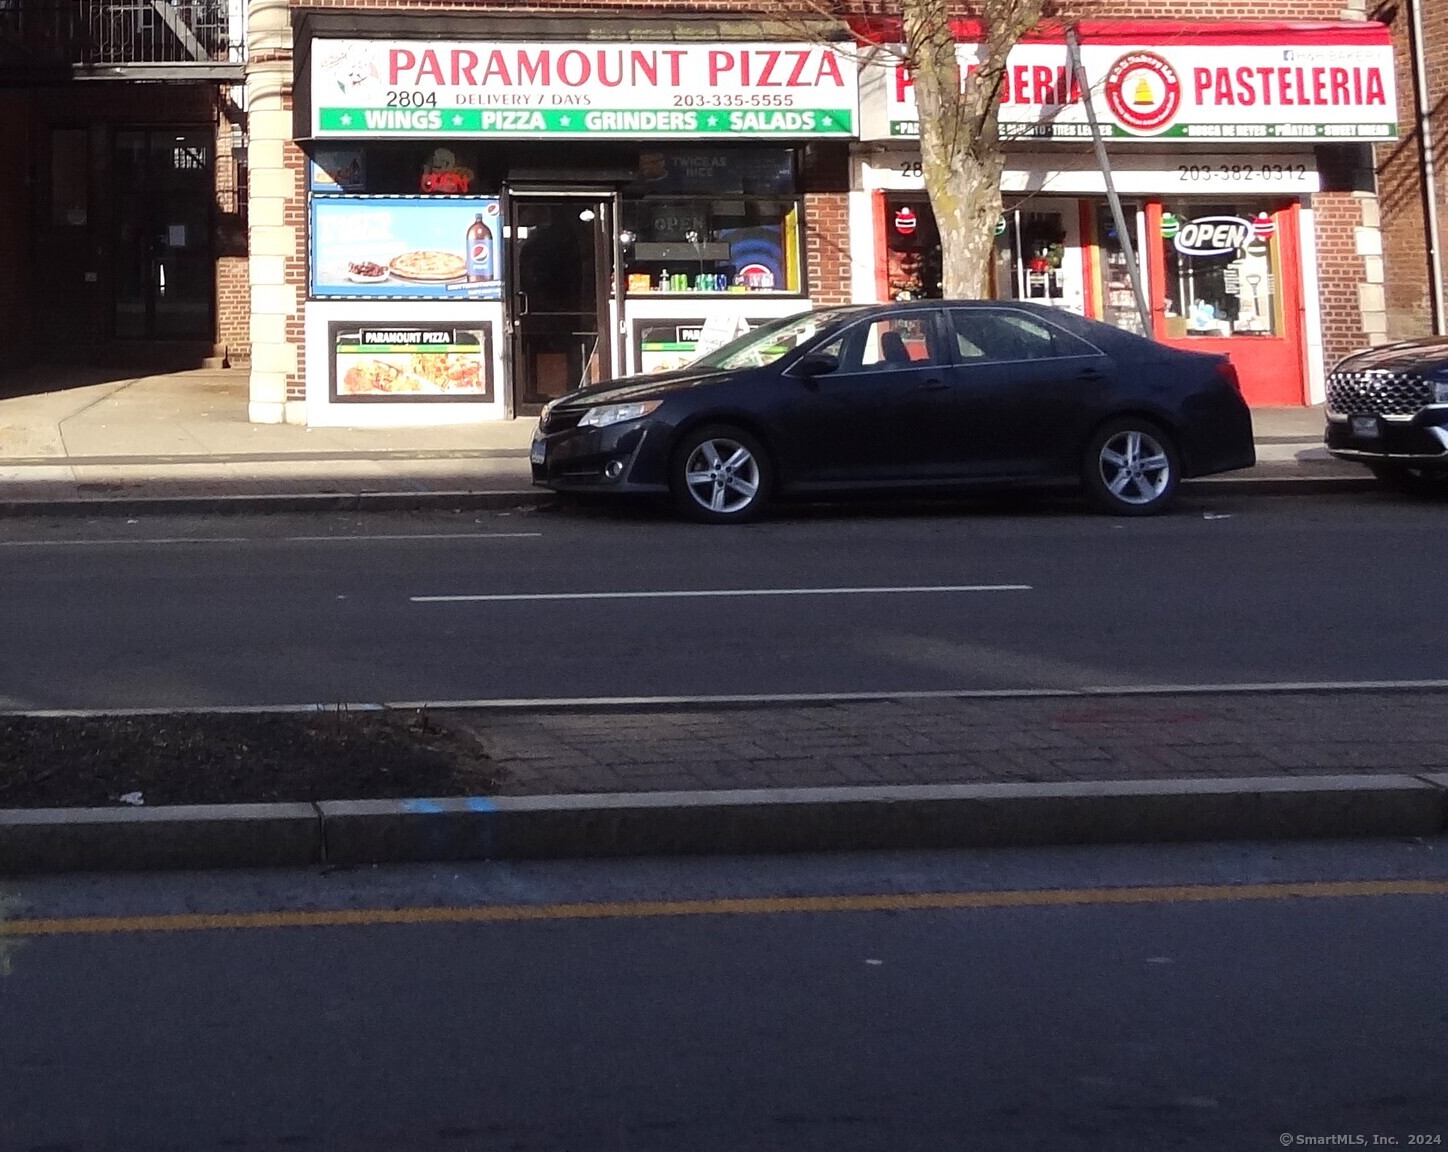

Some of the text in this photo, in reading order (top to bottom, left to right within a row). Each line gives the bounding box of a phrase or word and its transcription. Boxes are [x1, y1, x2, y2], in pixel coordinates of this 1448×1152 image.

[388, 49, 846, 88] PARAMOUNT PIZZA
[1193, 66, 1387, 106] PASTELERIA
[385, 90, 438, 108] 2804
[455, 93, 592, 106] DELIVERY 7 DAYS
[673, 94, 794, 107] 203-335-5555
[364, 110, 816, 131] WINGS PIZZA GRINDERS SALADS
[1178, 164, 1307, 181] 203-382-0312
[654, 217, 703, 233] OPEN
[1180, 224, 1245, 248] OPEN
[365, 331, 450, 344] PARAMOUNT PIZZA
